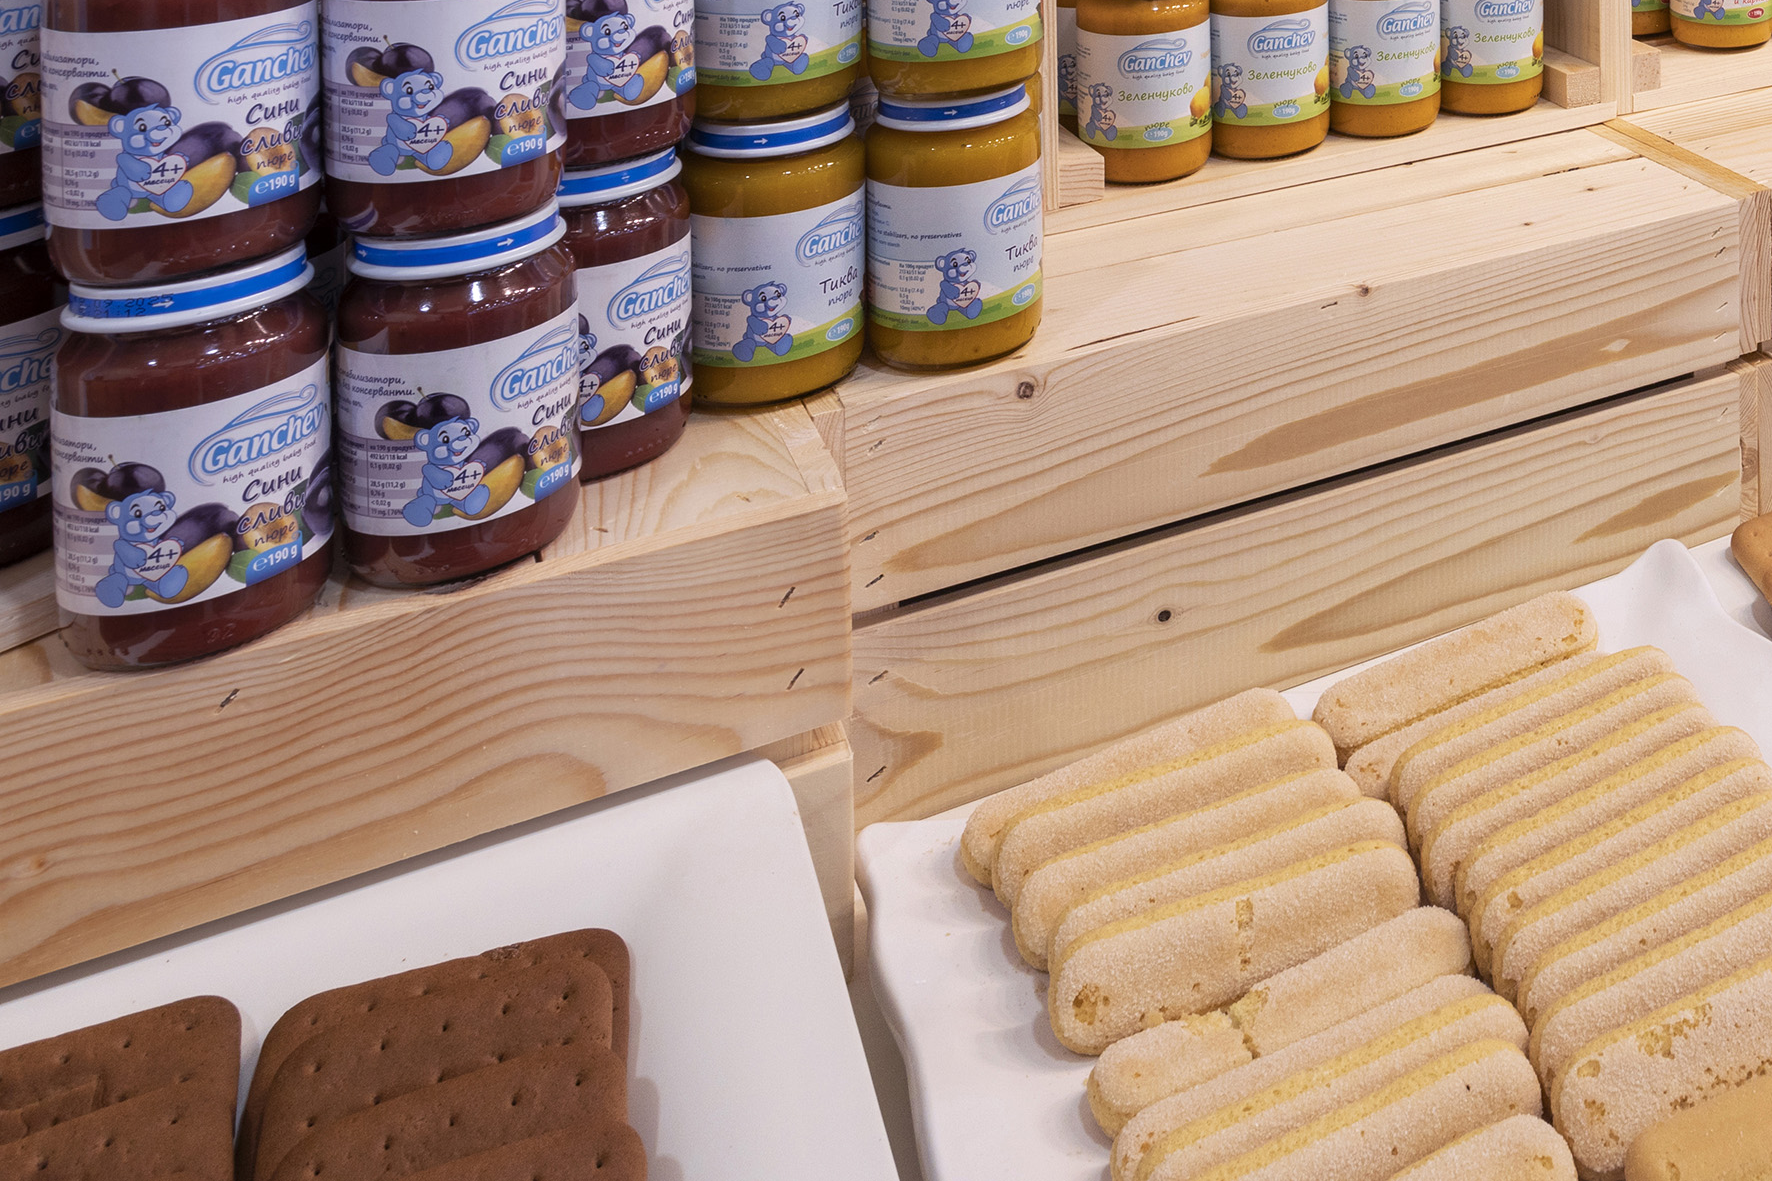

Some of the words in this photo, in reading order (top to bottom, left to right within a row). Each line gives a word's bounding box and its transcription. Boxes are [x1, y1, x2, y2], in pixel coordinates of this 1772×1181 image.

[1382, 11, 1436, 35] Ganchev
[467, 14, 565, 61] Ganchev
[787, 42, 802, 51] 4+
[1253, 29, 1316, 53] Ganchev
[1474, 27, 1536, 43] Зеленчуково
[207, 40, 318, 93] Ganchev
[614, 59, 637, 73] 4+
[1123, 51, 1192, 74] Ganchev
[1247, 61, 1318, 81] Зеленчуково
[500, 66, 548, 91] Сини
[227, 93, 248, 104] high
[252, 86, 281, 102] quality
[283, 79, 300, 96] baby
[1118, 82, 1194, 102] Зеленчуково
[246, 97, 299, 126] Сини
[417, 123, 444, 137] 4+
[508, 116, 542, 134] пюре
[409, 137, 437, 146] месеца
[152, 162, 184, 177] 4+
[256, 152, 294, 171] пюре
[143, 176, 176, 187] месеца
[1005, 233, 1038, 261] Тиква
[819, 265, 859, 295] Тиква
[828, 289, 854, 307] пюре
[643, 319, 682, 345] Сини
[531, 393, 572, 426] Сини
[202, 402, 325, 474] Ganchev
[222, 473, 245, 483] high
[248, 460, 280, 479] quality
[282, 449, 302, 465] baby
[454, 469, 482, 483] 4+
[242, 466, 303, 503] Сини
[446, 483, 475, 493] месеца
[236, 491, 306, 535] сливи
[254, 522, 296, 547] пюре
[147, 545, 178, 562] 4+
[139, 562, 171, 573] месеца
